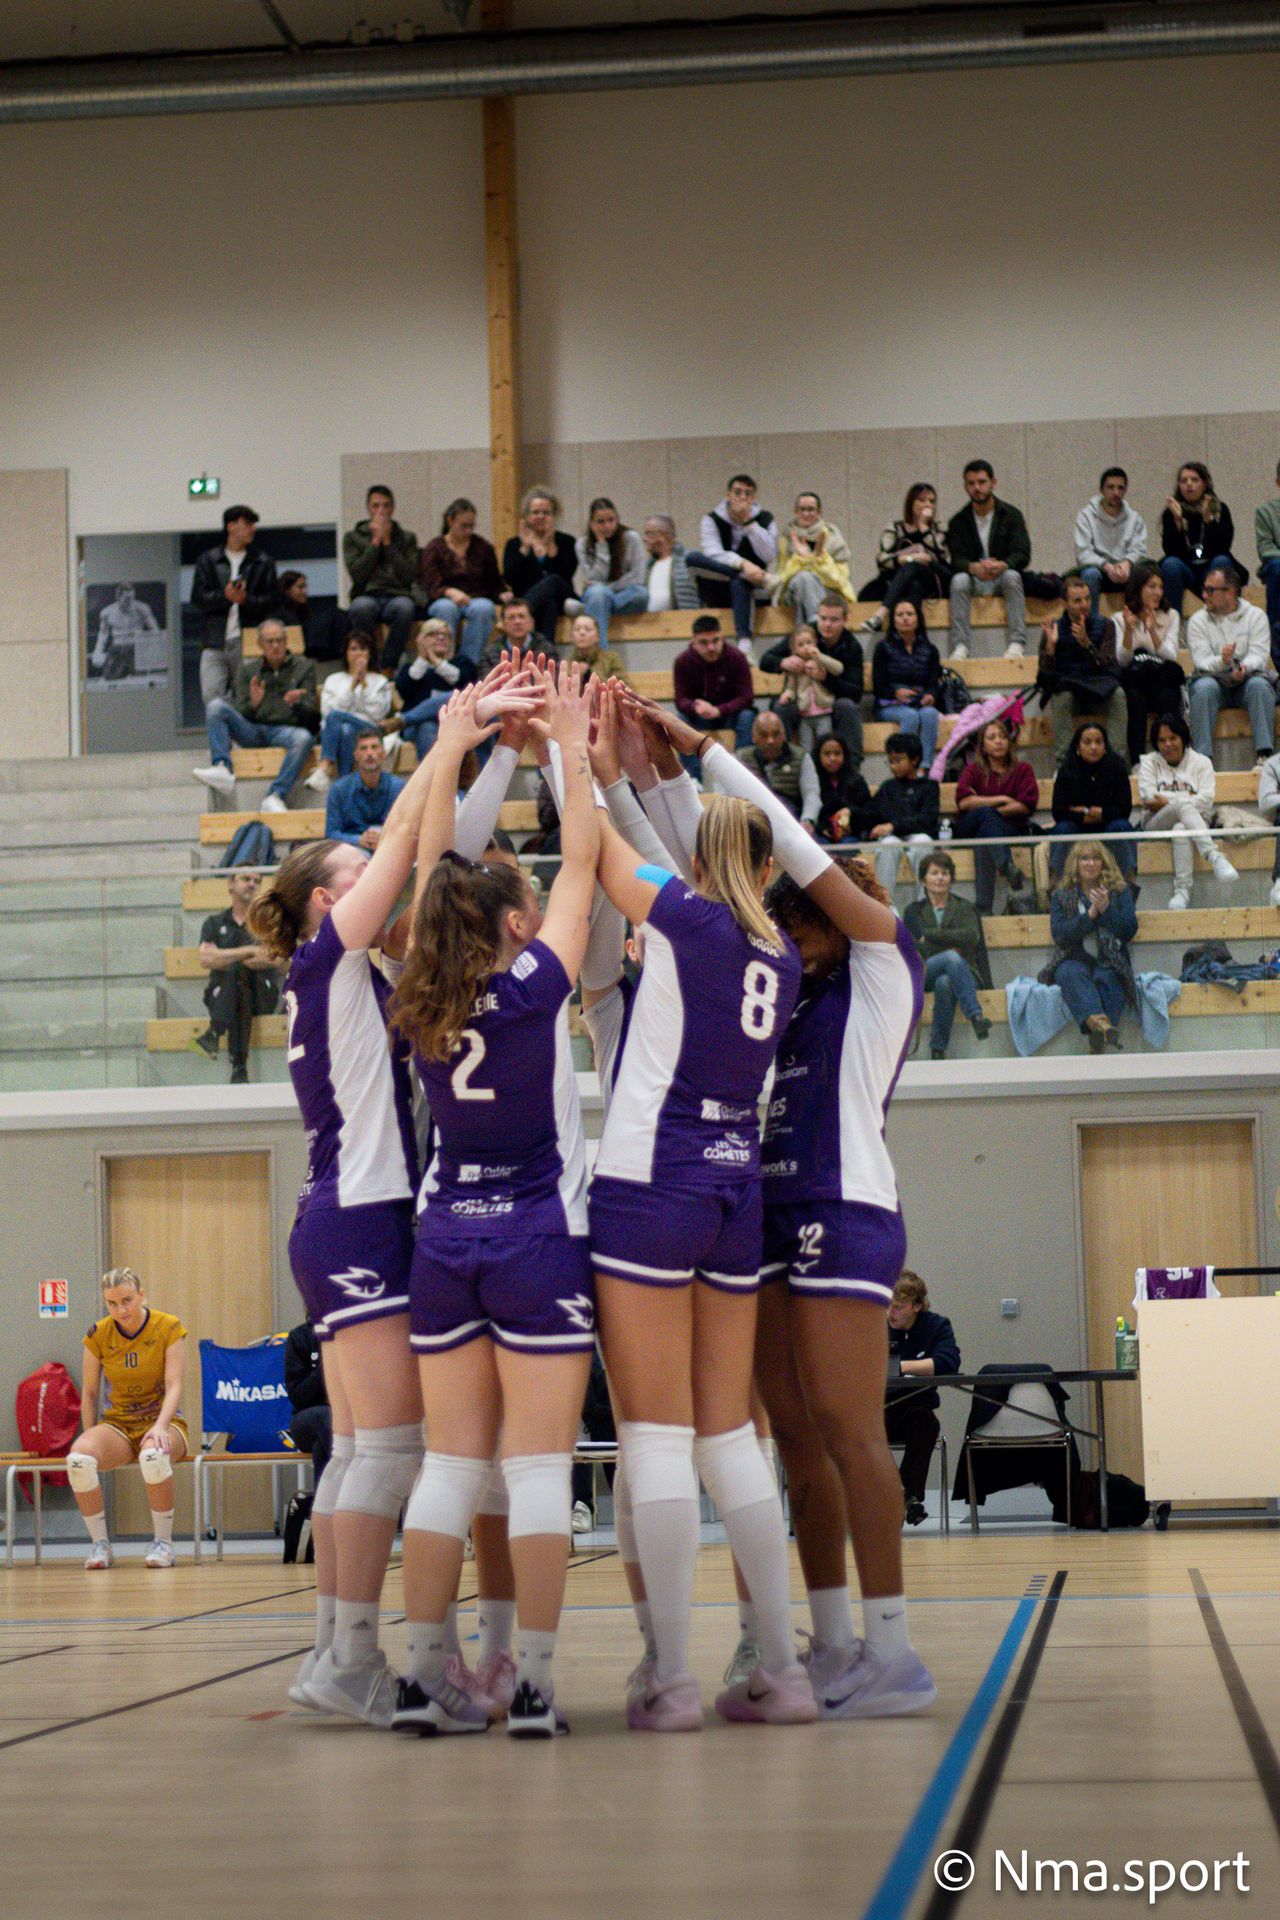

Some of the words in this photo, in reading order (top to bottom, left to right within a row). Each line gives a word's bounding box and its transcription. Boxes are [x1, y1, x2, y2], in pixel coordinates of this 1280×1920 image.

[741, 961, 778, 1040] 8
[448, 1028, 496, 1100] 2
[798, 1222, 823, 1255] 12
[125, 1352, 138, 1368] 10
